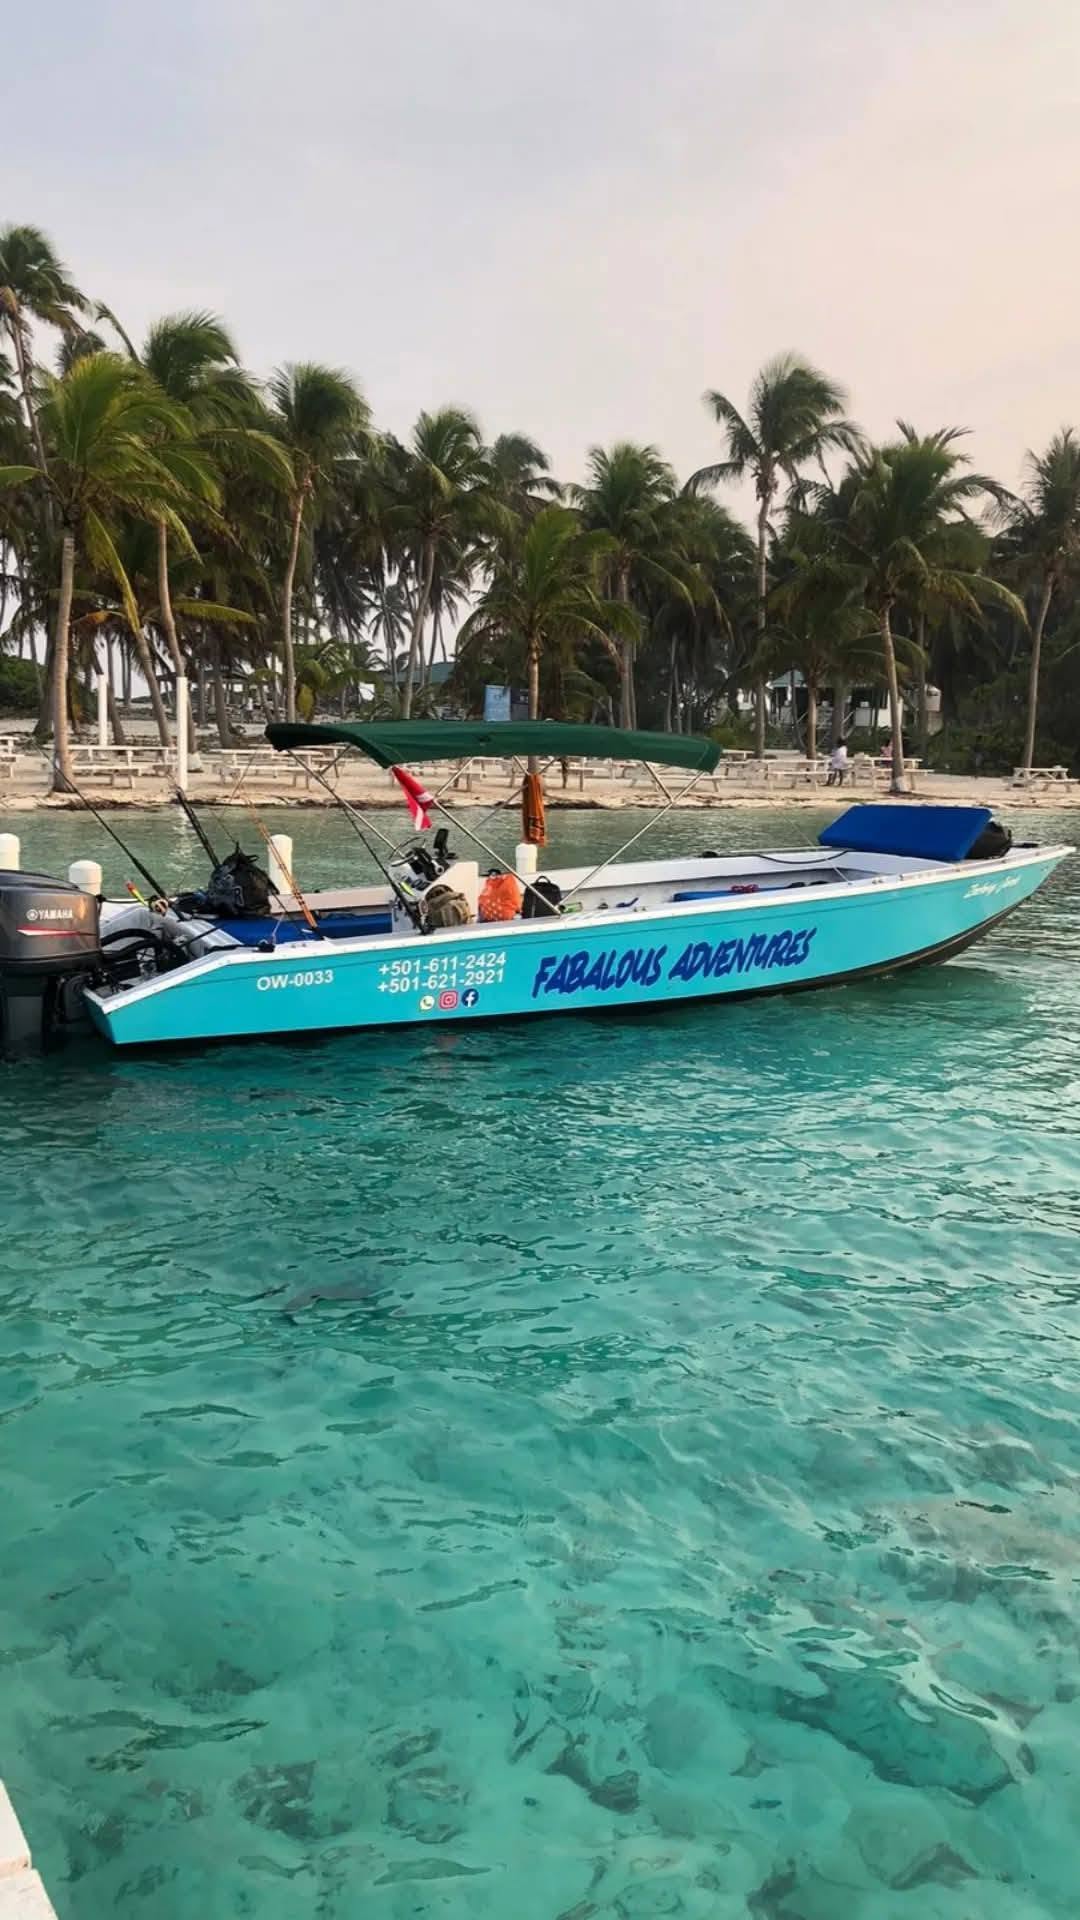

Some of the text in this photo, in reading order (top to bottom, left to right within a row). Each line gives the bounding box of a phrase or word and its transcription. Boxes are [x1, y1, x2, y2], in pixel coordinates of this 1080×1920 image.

[38, 909, 74, 920] YAMAHA
[379, 952, 507, 976] +501-611-2424
[532, 927, 817, 998] FABALOUS ADVENTURES
[257, 969, 334, 991] OW-0033
[377, 969, 505, 993] +501-621-2921
